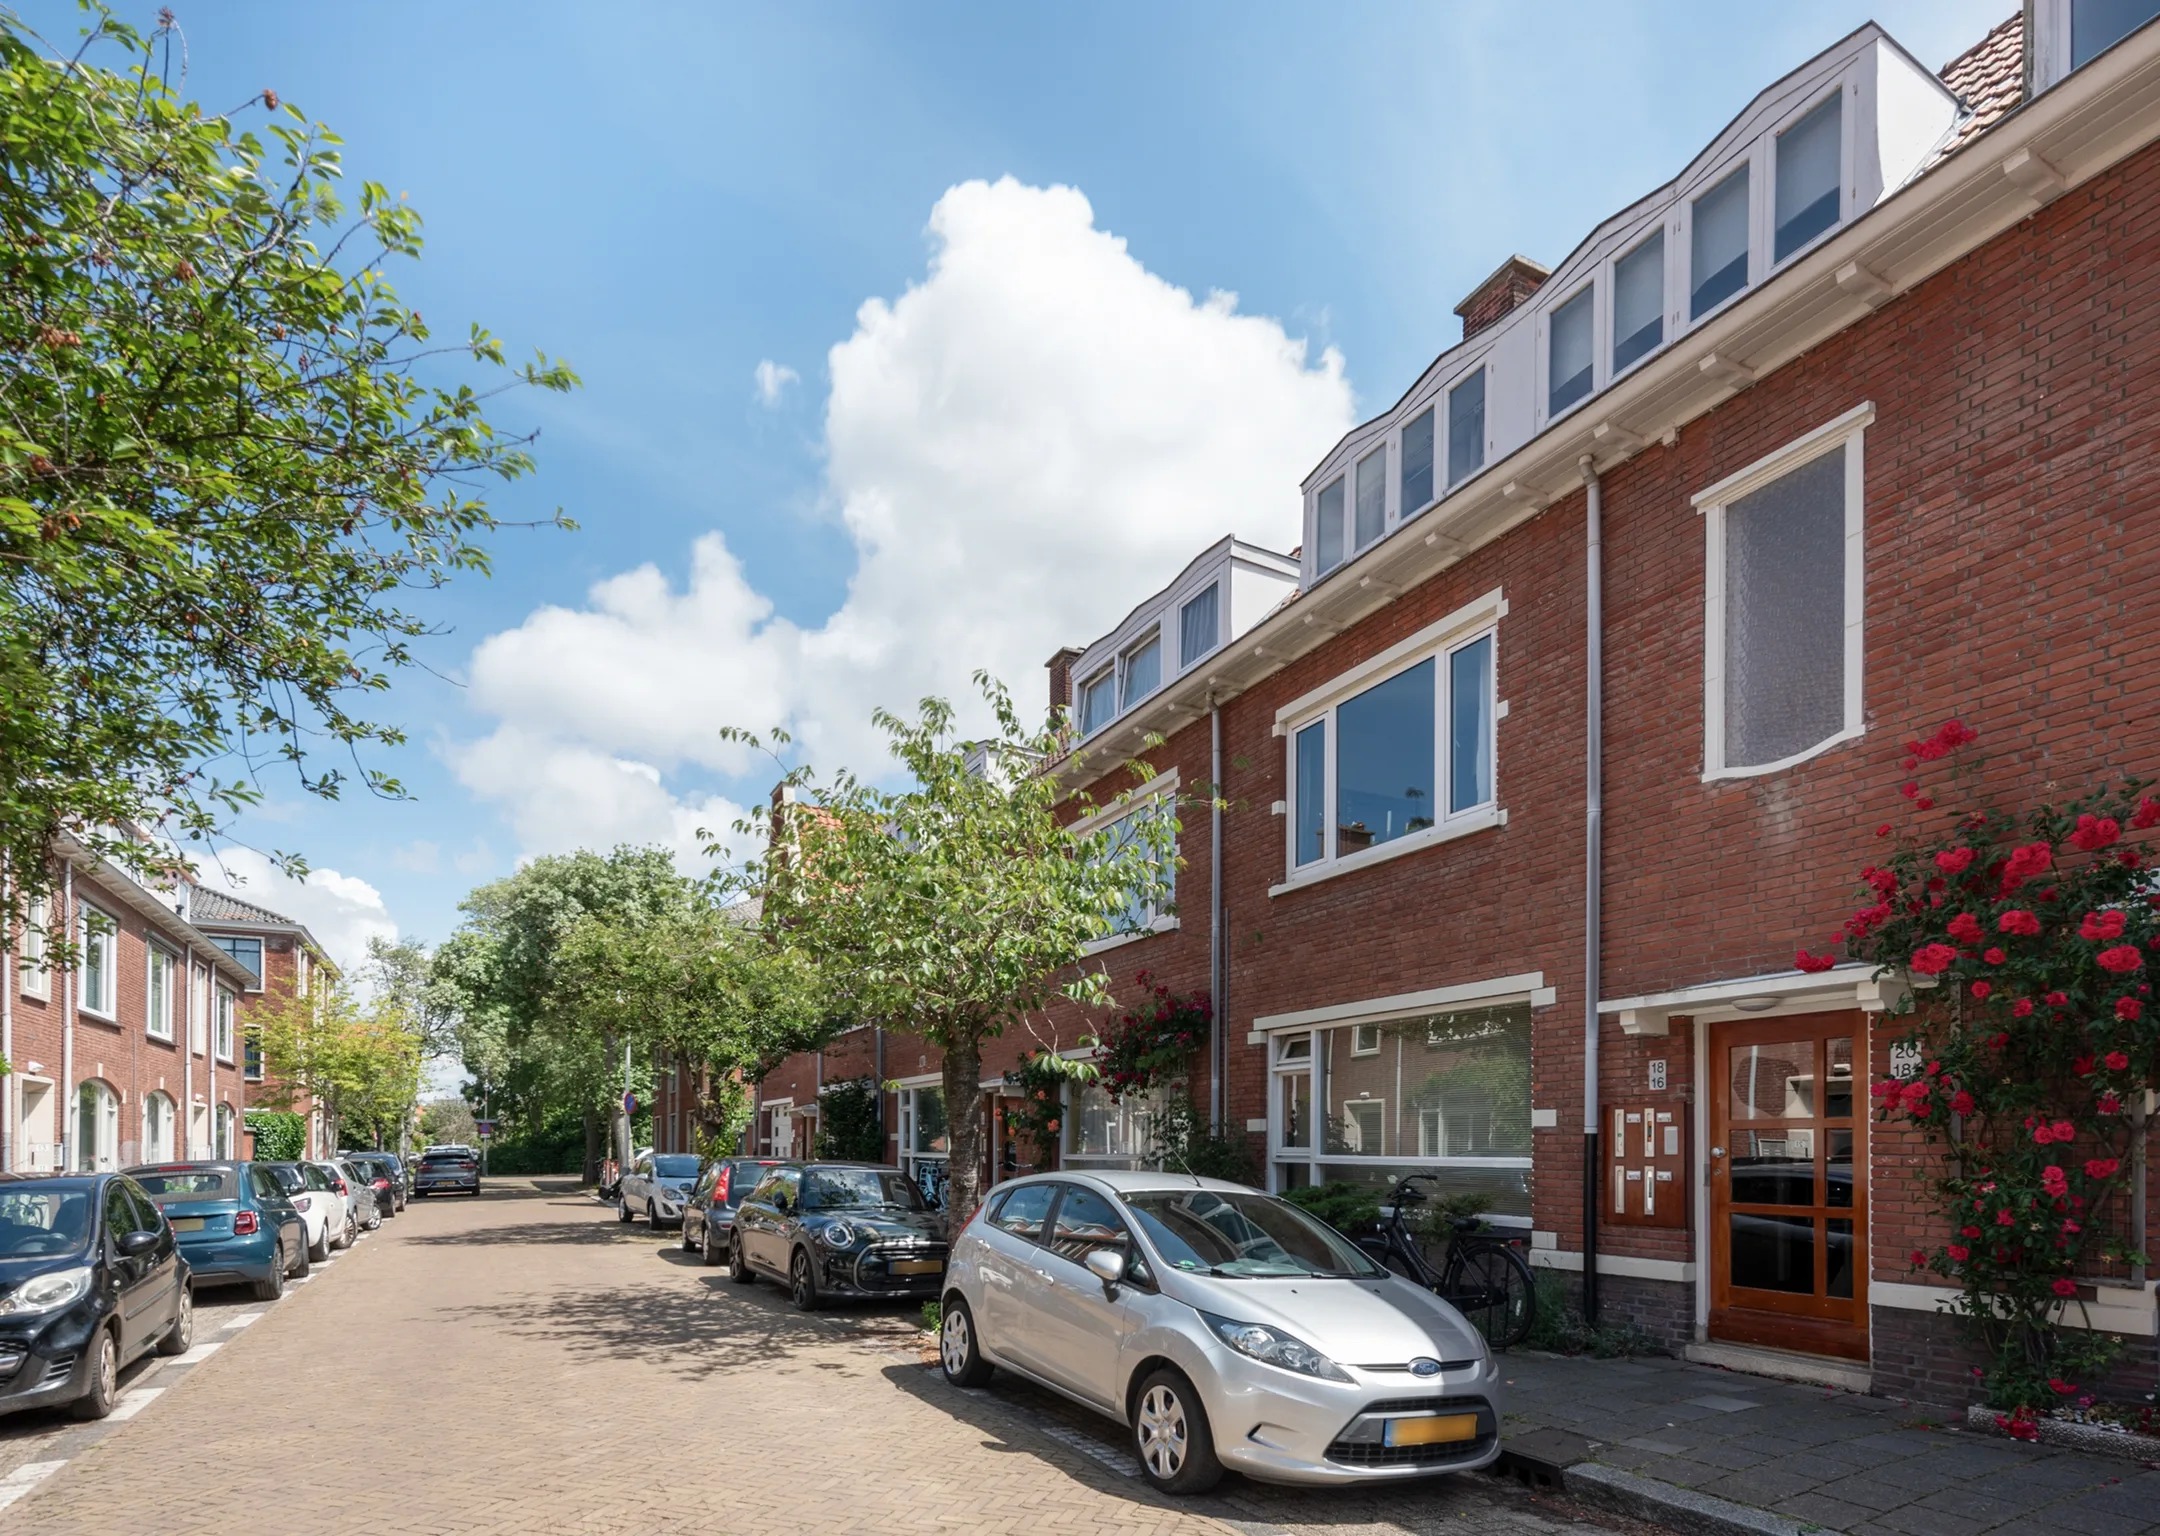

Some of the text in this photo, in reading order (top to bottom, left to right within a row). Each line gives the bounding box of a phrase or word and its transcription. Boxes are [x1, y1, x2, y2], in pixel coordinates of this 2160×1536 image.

[1652, 1062, 1664, 1073] 18
[1893, 1063, 1911, 1077] 18
[1652, 1077, 1664, 1088] 16
